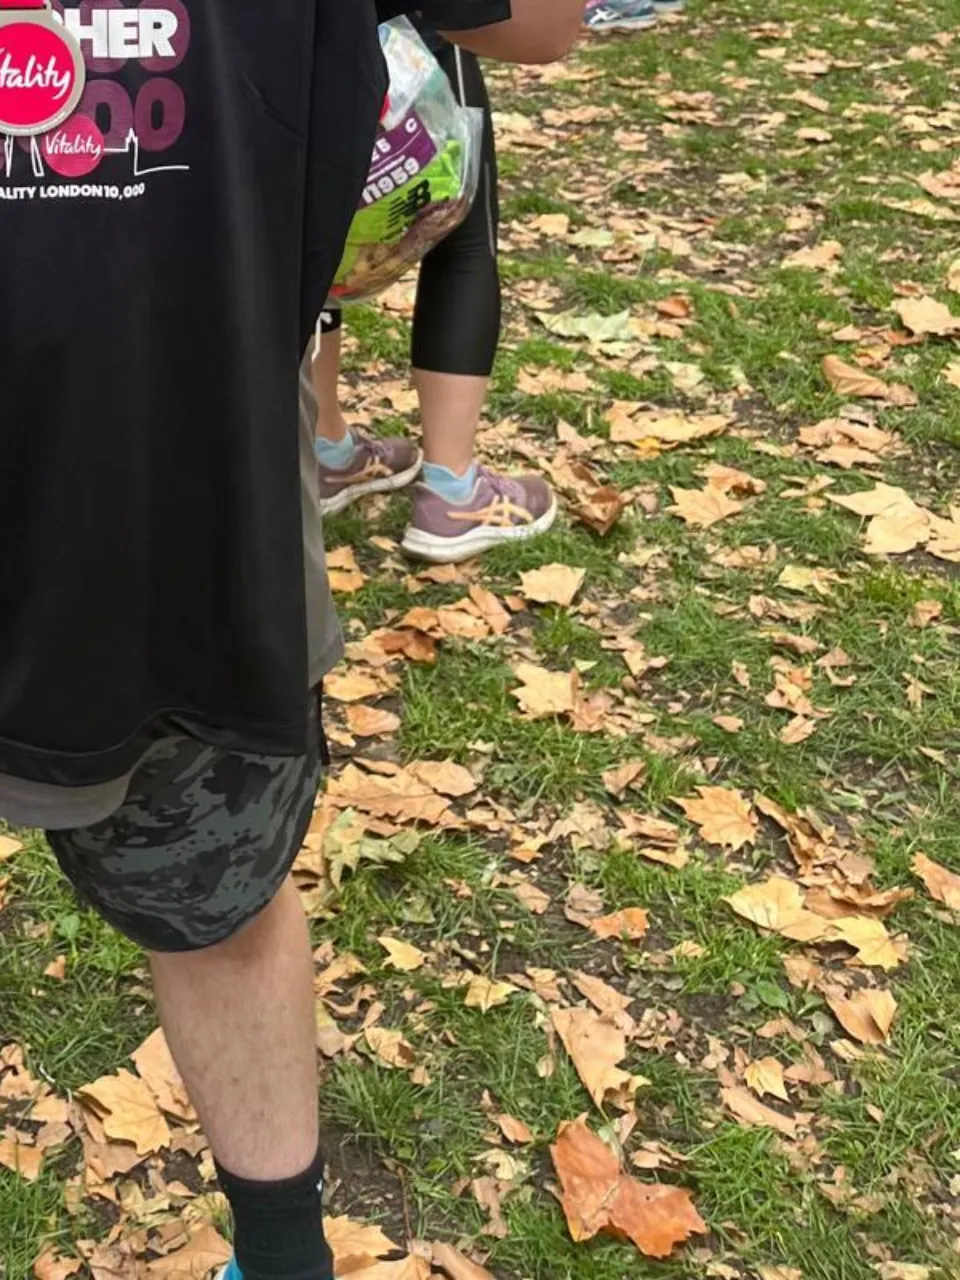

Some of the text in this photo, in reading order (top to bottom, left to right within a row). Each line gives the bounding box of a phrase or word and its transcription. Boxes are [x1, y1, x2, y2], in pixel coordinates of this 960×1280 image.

[45, 130, 103, 160] Vitality
[39, 183, 103, 199] LONDON
[103, 182, 146, 201] 10,000
